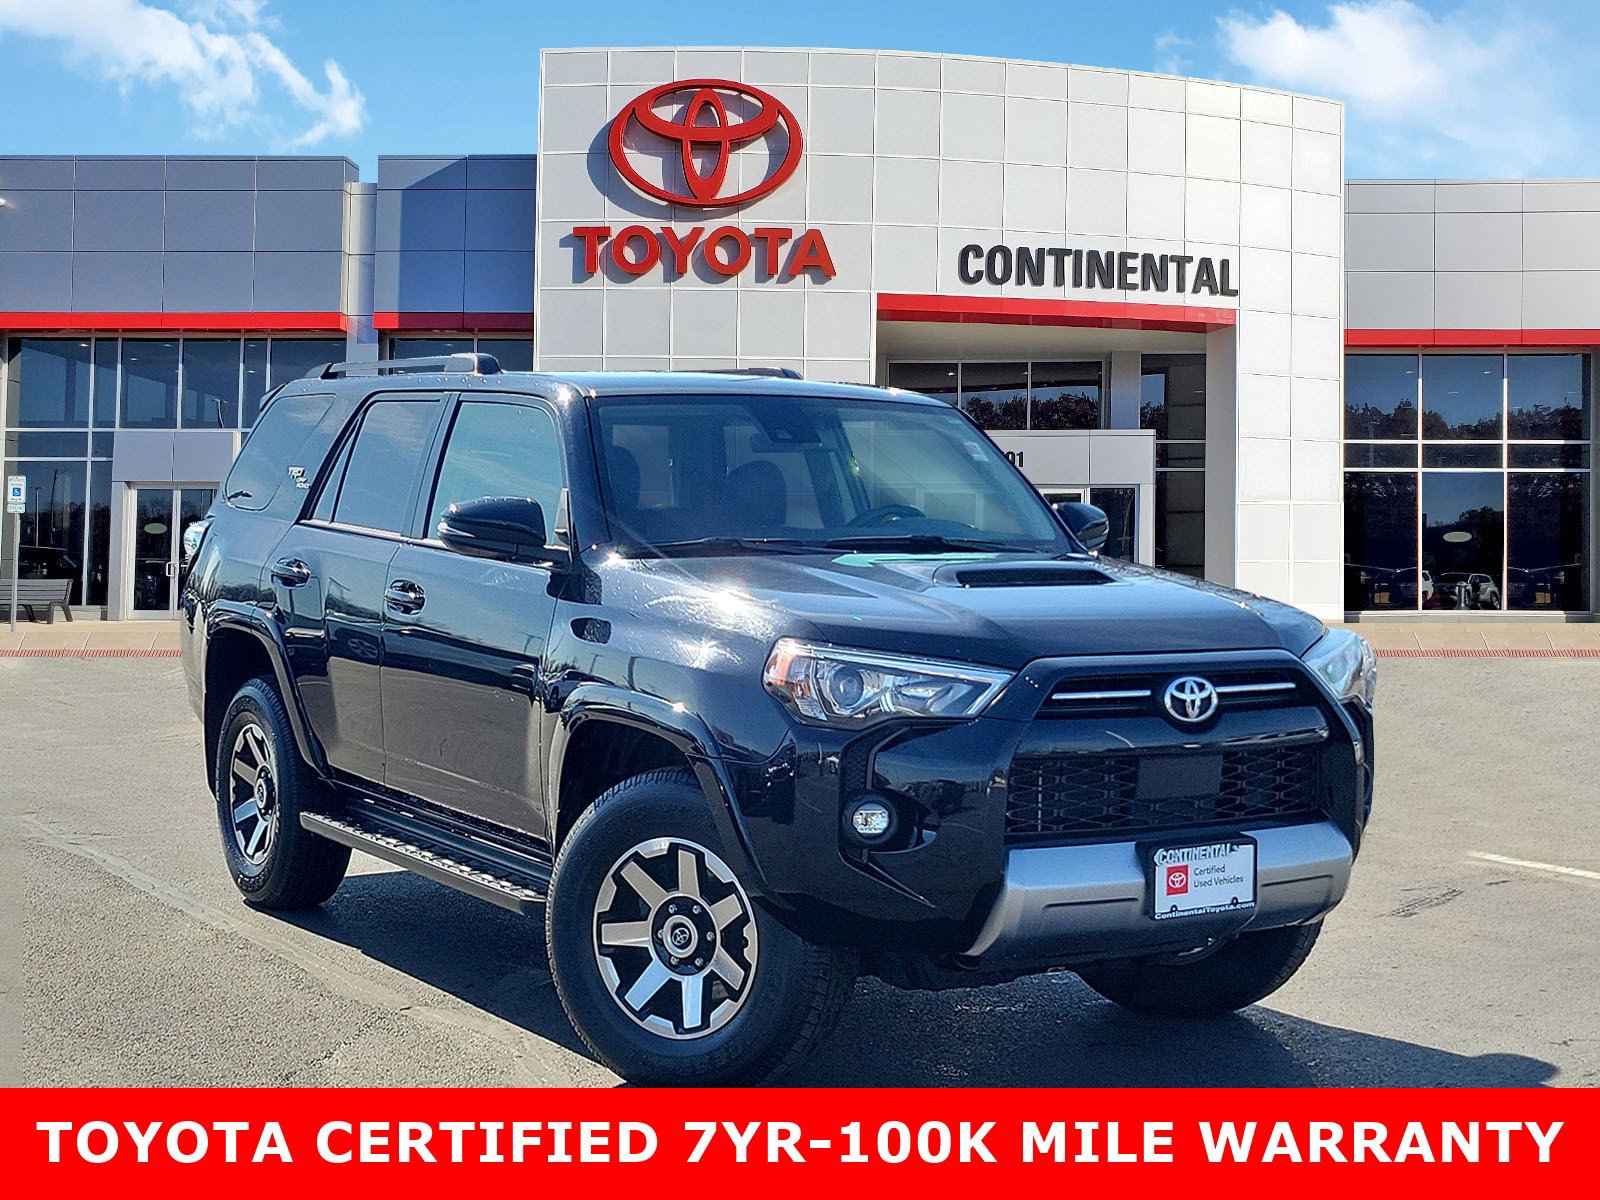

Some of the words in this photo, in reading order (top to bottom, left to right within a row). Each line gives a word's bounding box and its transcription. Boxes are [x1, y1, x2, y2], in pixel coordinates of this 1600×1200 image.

[573, 225, 836, 277] TOYOTA
[958, 244, 1239, 297] CONTINENTAL
[1160, 843, 1232, 864] CONTINENTAL
[1193, 864, 1226, 876] Certified
[1193, 878, 1213, 888] Used
[1214, 875, 1244, 886] Vehicles
[1154, 901, 1255, 920] ContinentalToyota.com
